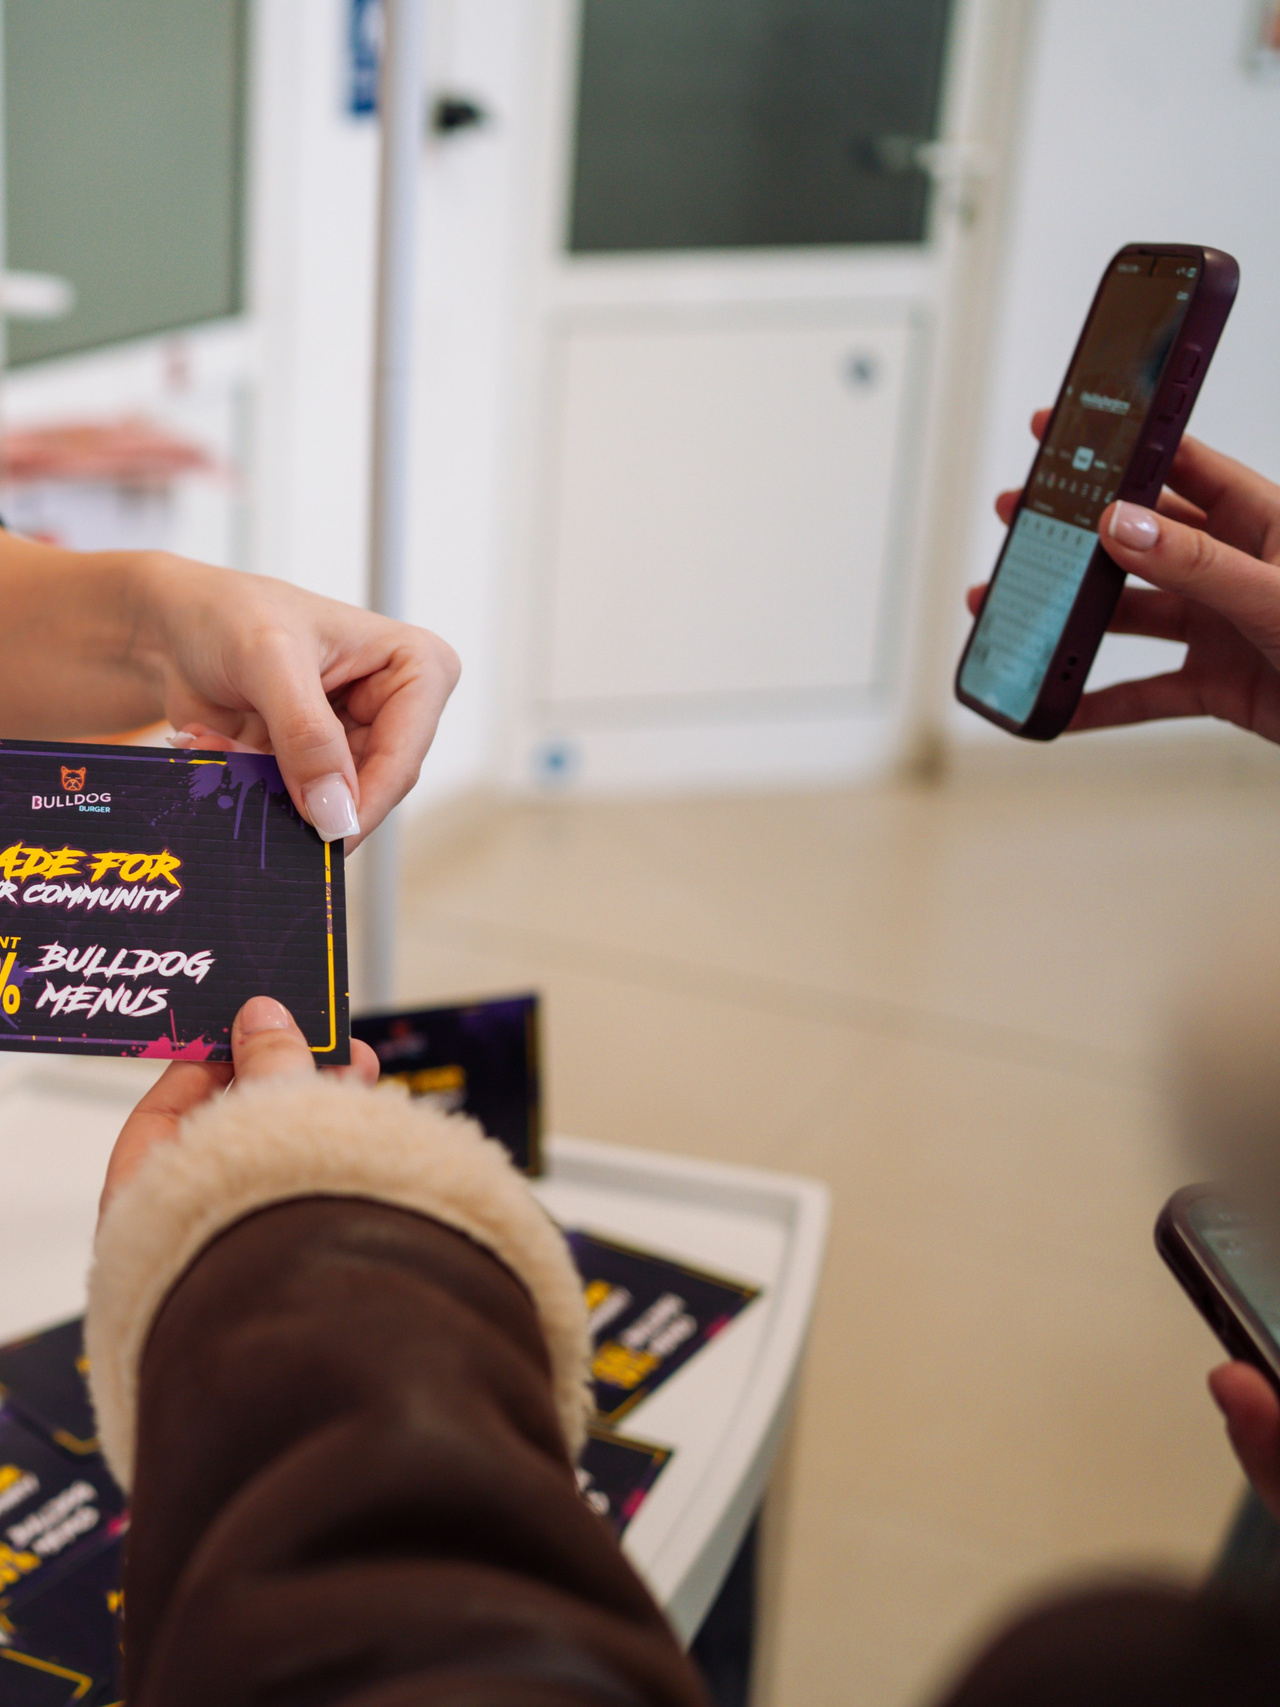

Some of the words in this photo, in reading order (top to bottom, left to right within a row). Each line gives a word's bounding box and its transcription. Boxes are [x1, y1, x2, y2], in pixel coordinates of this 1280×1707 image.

[31, 792, 112, 810] BULLDOG
[78, 805, 111, 813] BURGER
[86, 849, 182, 889] FOR
[23, 881, 182, 912] COMMUNITY
[25, 941, 217, 984] BULLDOG
[34, 979, 170, 1019] MENUS
